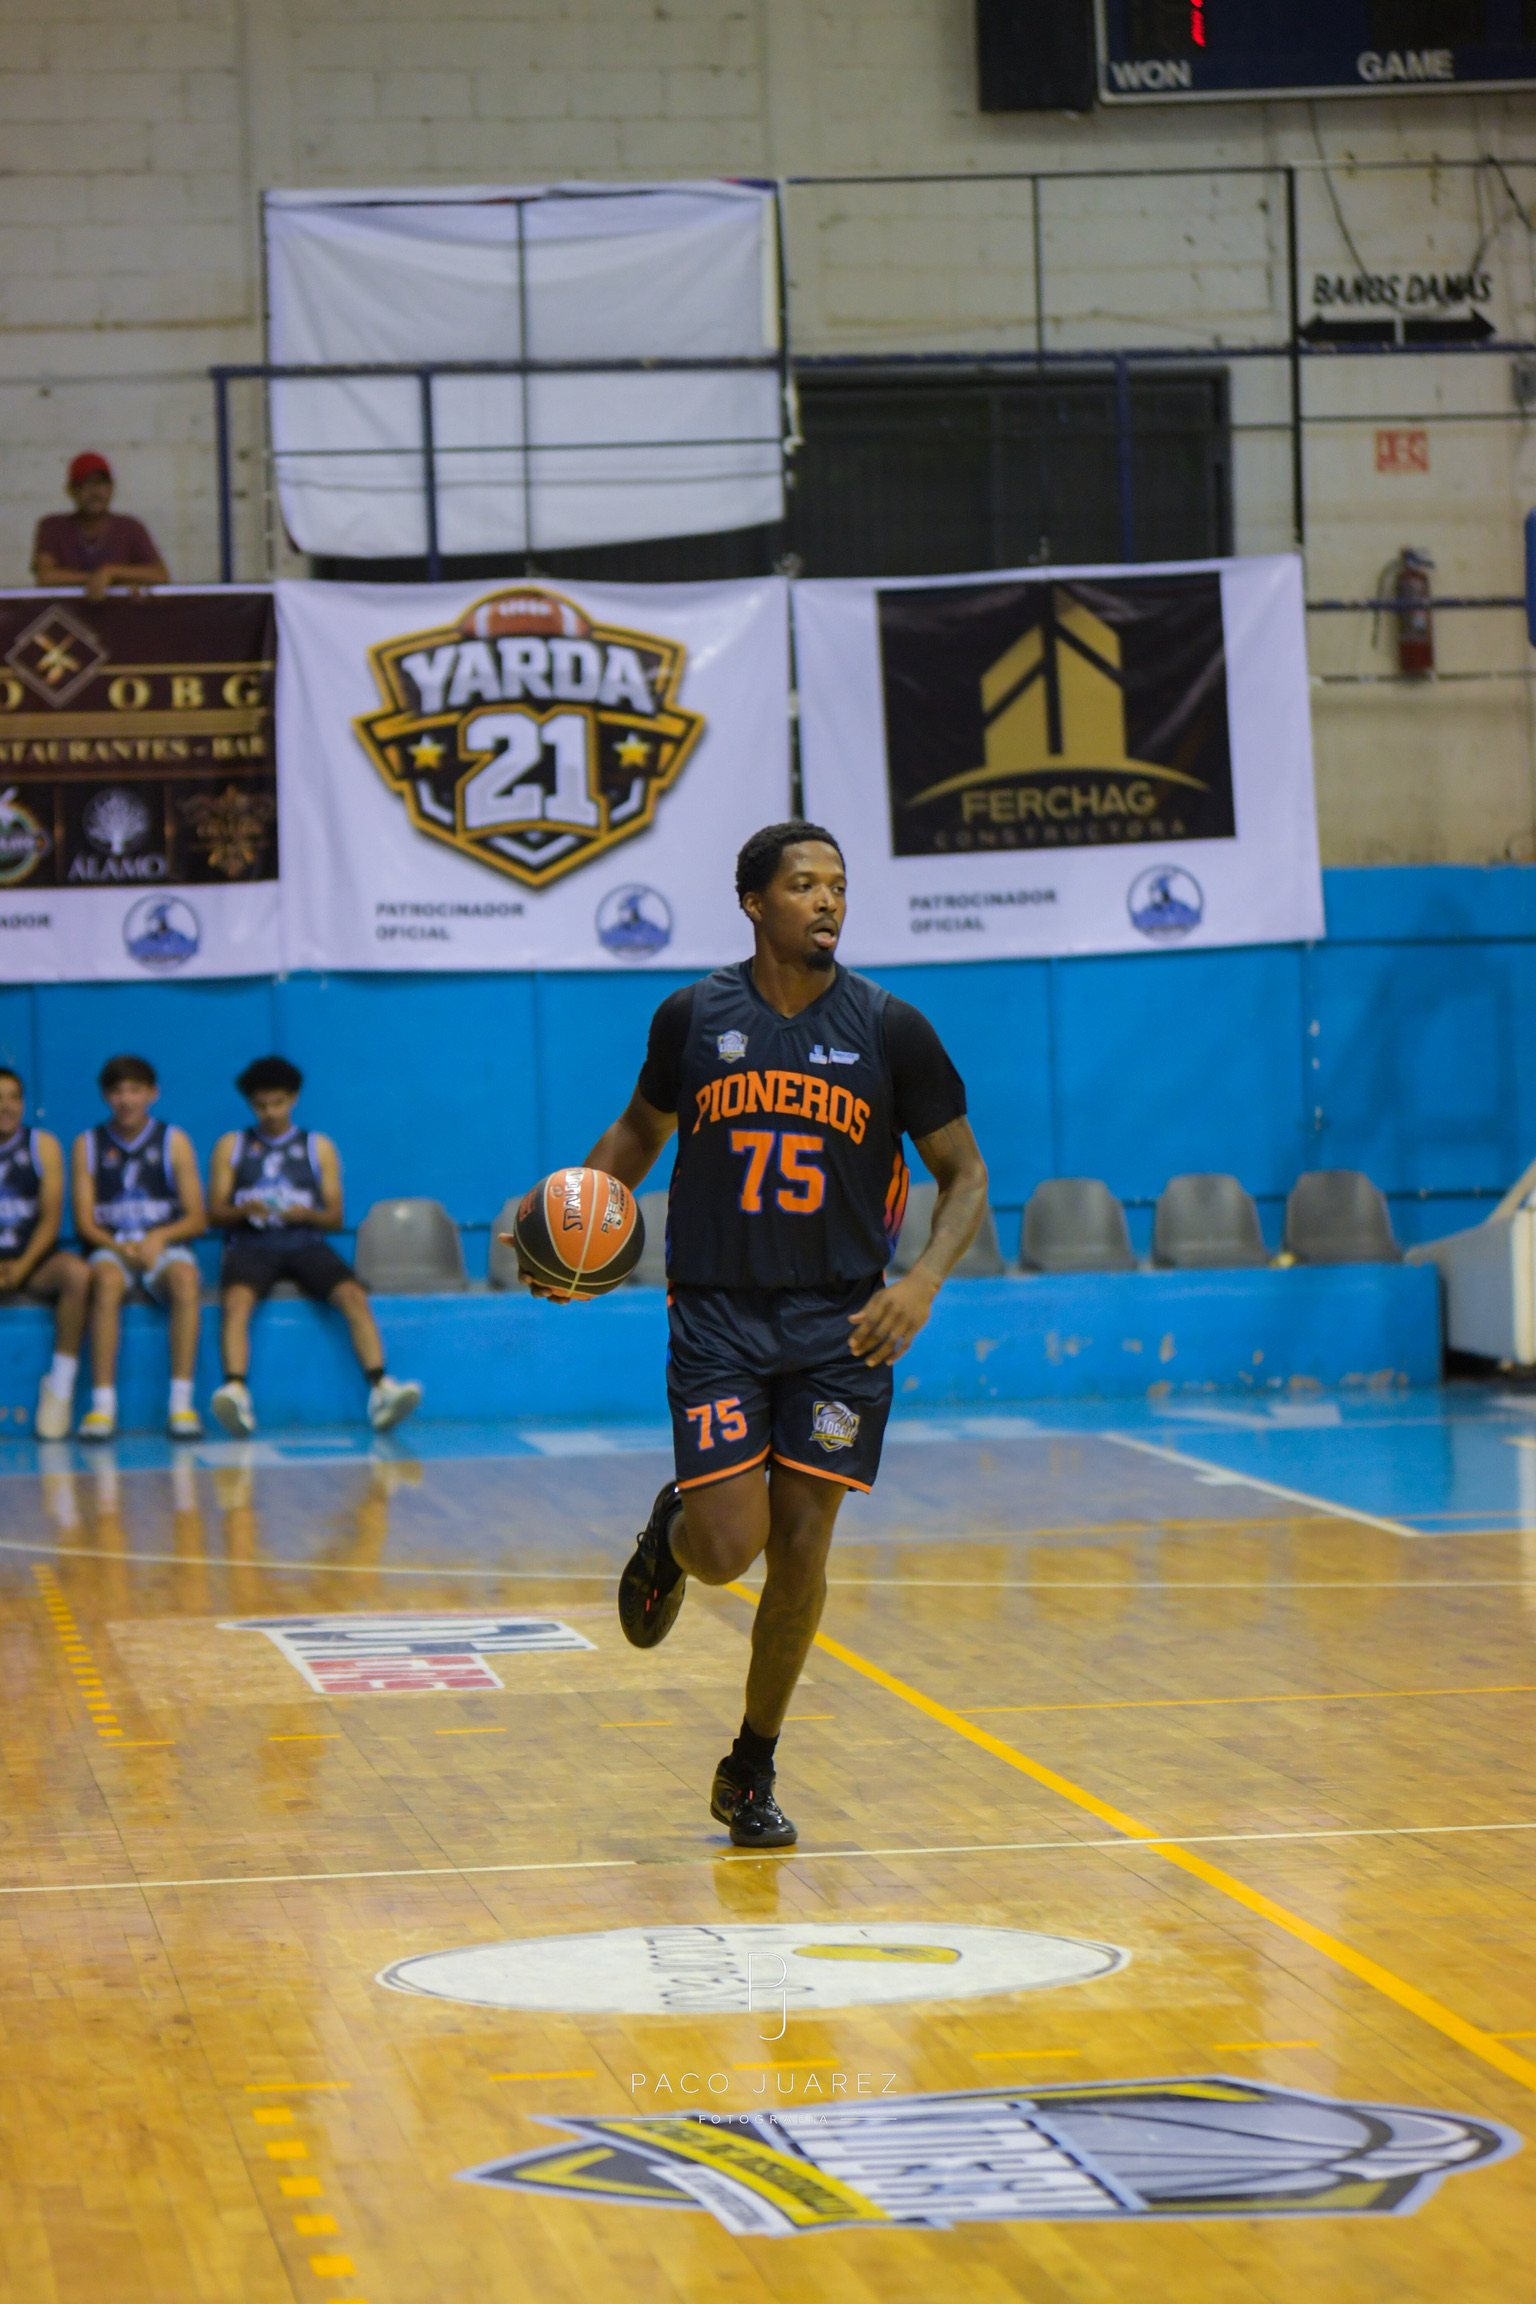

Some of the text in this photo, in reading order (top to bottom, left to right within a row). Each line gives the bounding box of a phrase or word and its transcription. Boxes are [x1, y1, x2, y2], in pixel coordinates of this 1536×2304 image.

[1111, 59, 1192, 91] WON
[1357, 49, 1455, 82] GAME
[401, 636, 655, 714] YARDA
[465, 712, 601, 830] 21
[961, 781, 1157, 826] FERCHAG
[934, 818, 1186, 850] CONSTRUCTORA
[67, 852, 168, 883] ALAMO
[375, 901, 526, 918] PATROCINADOR
[909, 889, 1057, 911] PATROCINADOR
[375, 924, 450, 941] OFICIAL
[910, 915, 984, 934] OFICIAL
[692, 1069, 870, 1145] PIONEROS
[729, 1129, 826, 1215] 75
[685, 1396, 748, 1451] 75
